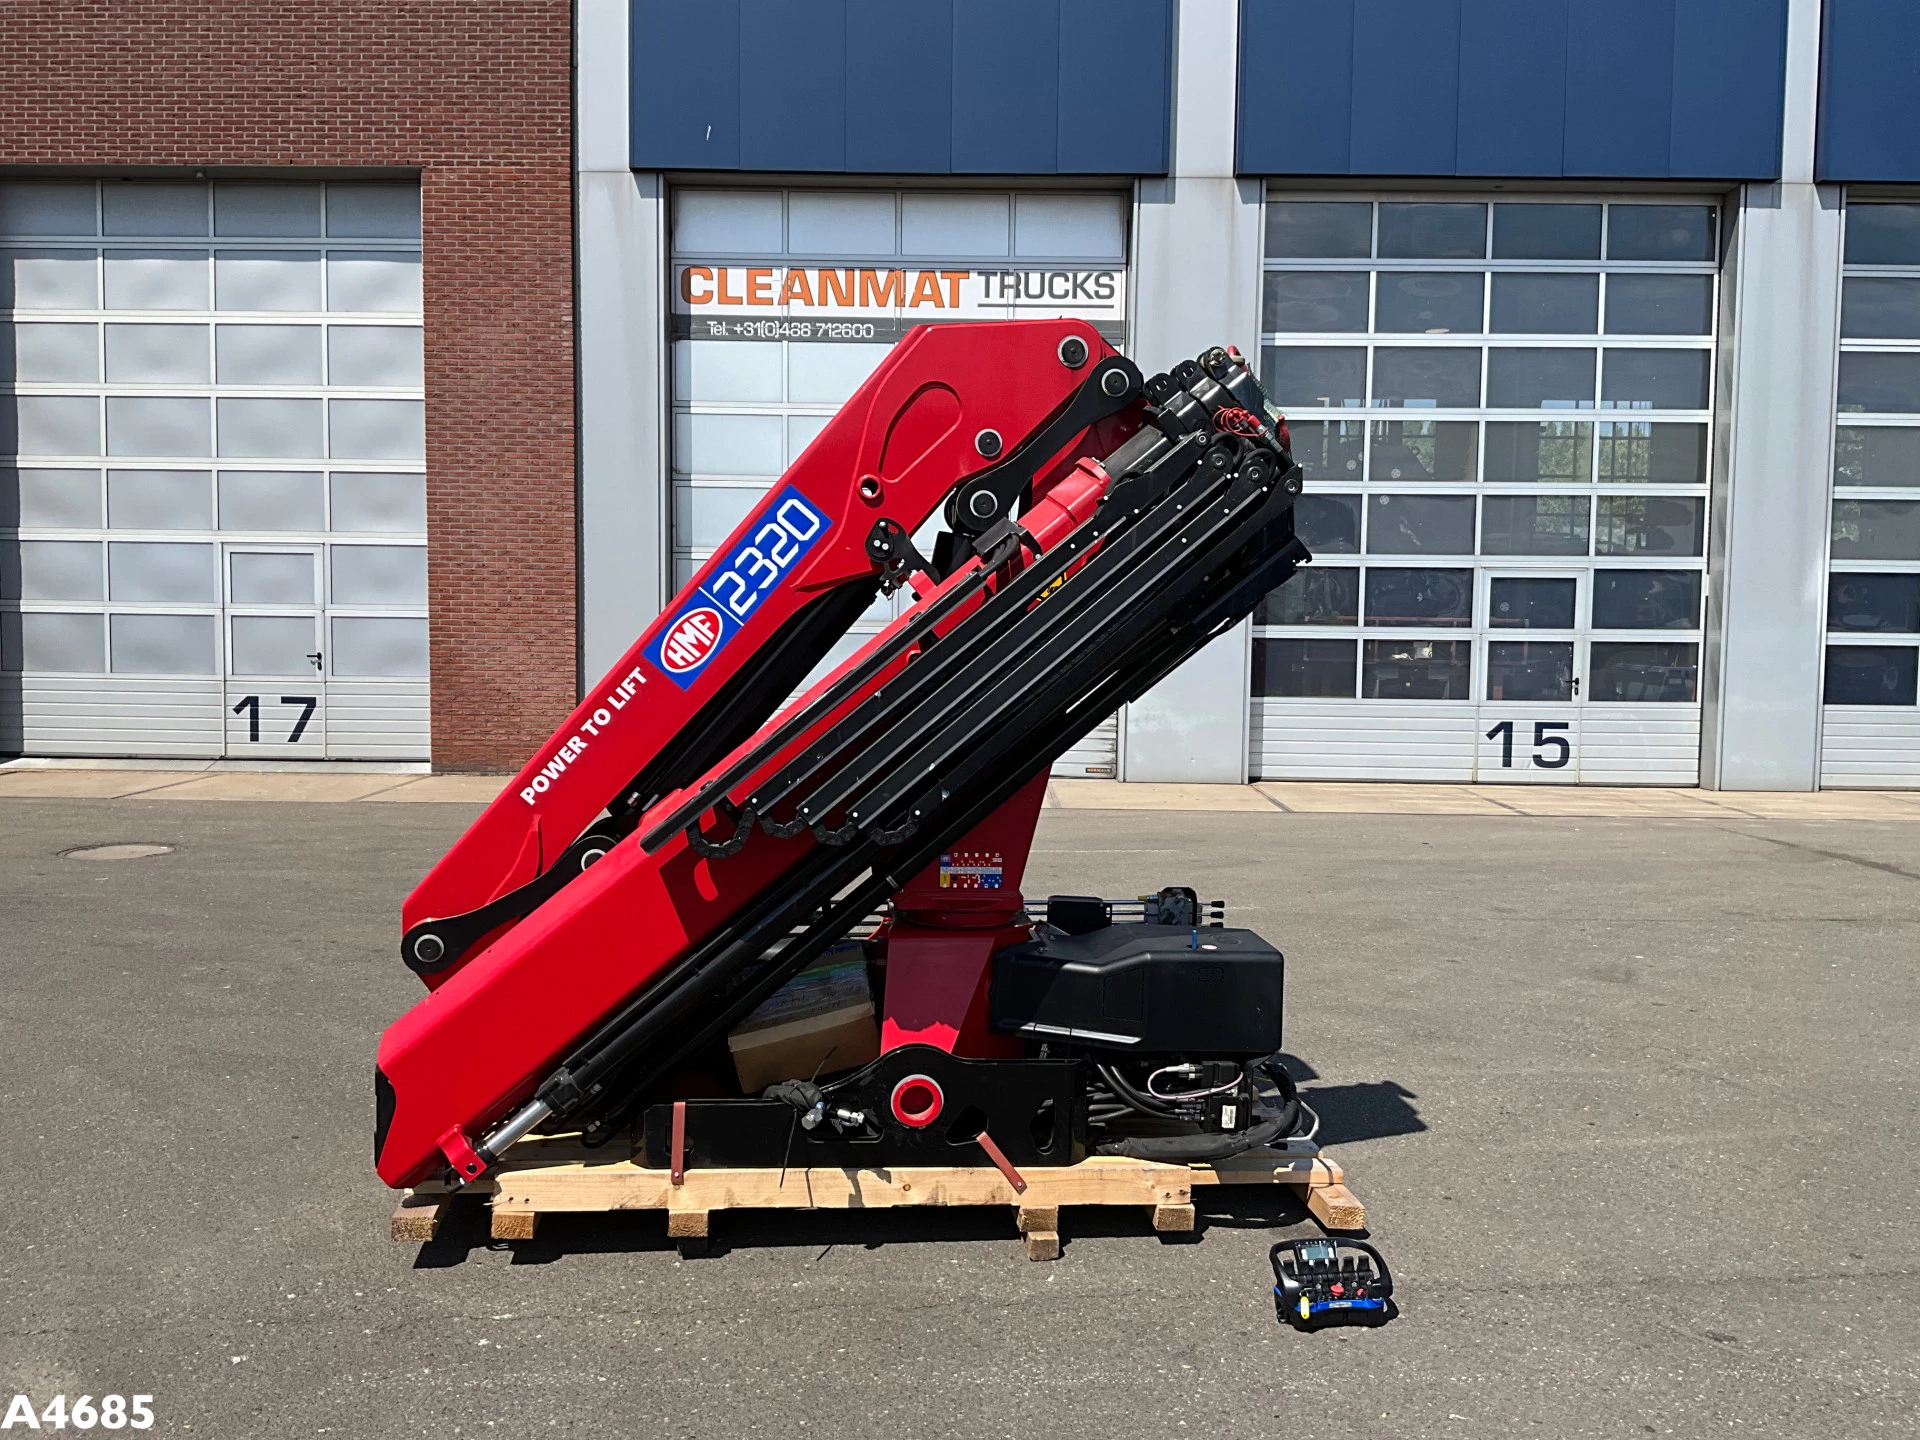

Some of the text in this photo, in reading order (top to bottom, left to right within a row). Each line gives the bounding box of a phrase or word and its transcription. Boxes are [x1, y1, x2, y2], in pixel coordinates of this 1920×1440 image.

[680, 266, 1115, 309] CLEANMAT TRUCKS
[707, 320, 874, 339] Tel. +31(0)488 712600
[713, 499, 820, 616] 2320
[667, 614, 715, 667] HMF
[233, 696, 317, 742] 17
[520, 666, 647, 806] POWER TO LIFT
[1485, 721, 1570, 768] 15
